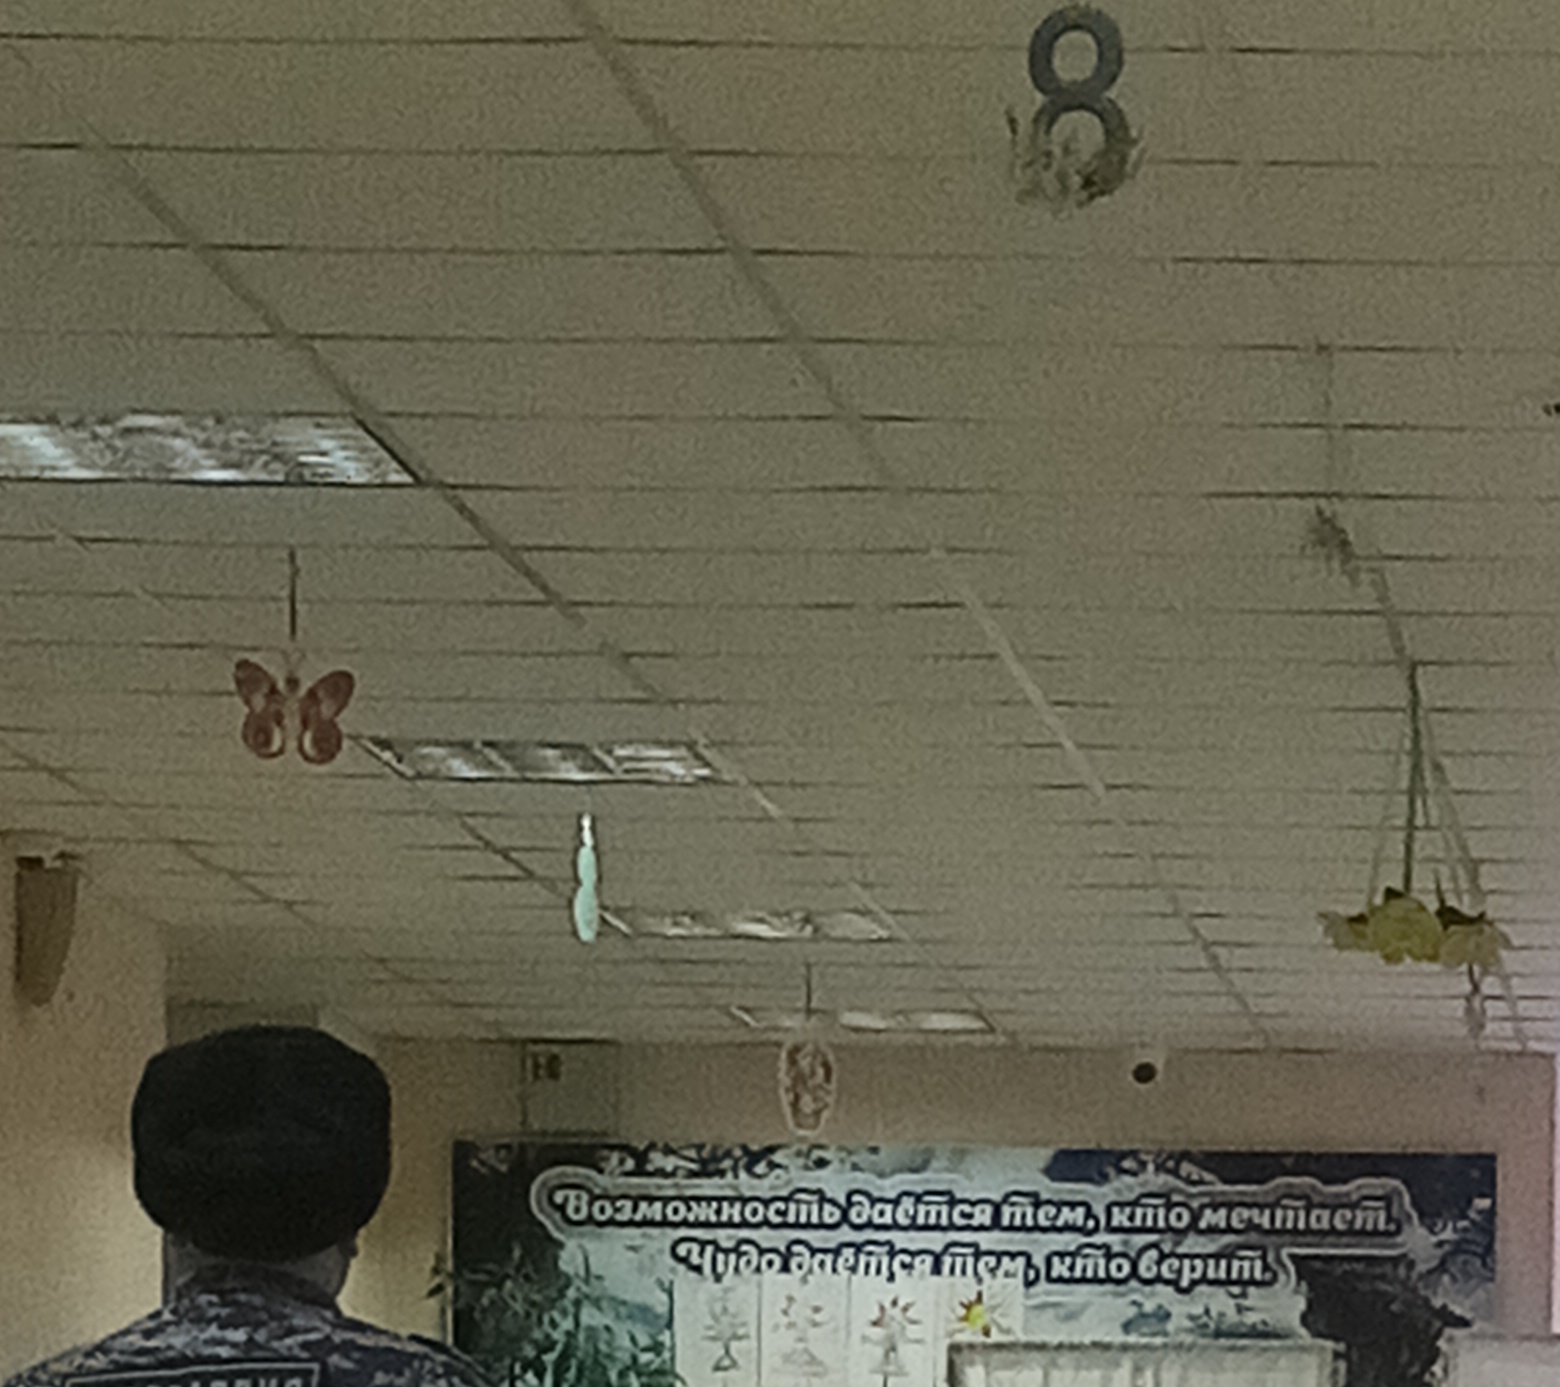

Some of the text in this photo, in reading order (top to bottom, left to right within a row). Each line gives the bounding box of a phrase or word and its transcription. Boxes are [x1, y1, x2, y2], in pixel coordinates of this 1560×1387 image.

[553, 1188, 1398, 1232] Возможность даётся тем, кто мечтает.
[675, 1240, 783, 1281] Чудо
[1049, 1247, 1131, 1279] кто
[1136, 1249, 1274, 1288] верит.
